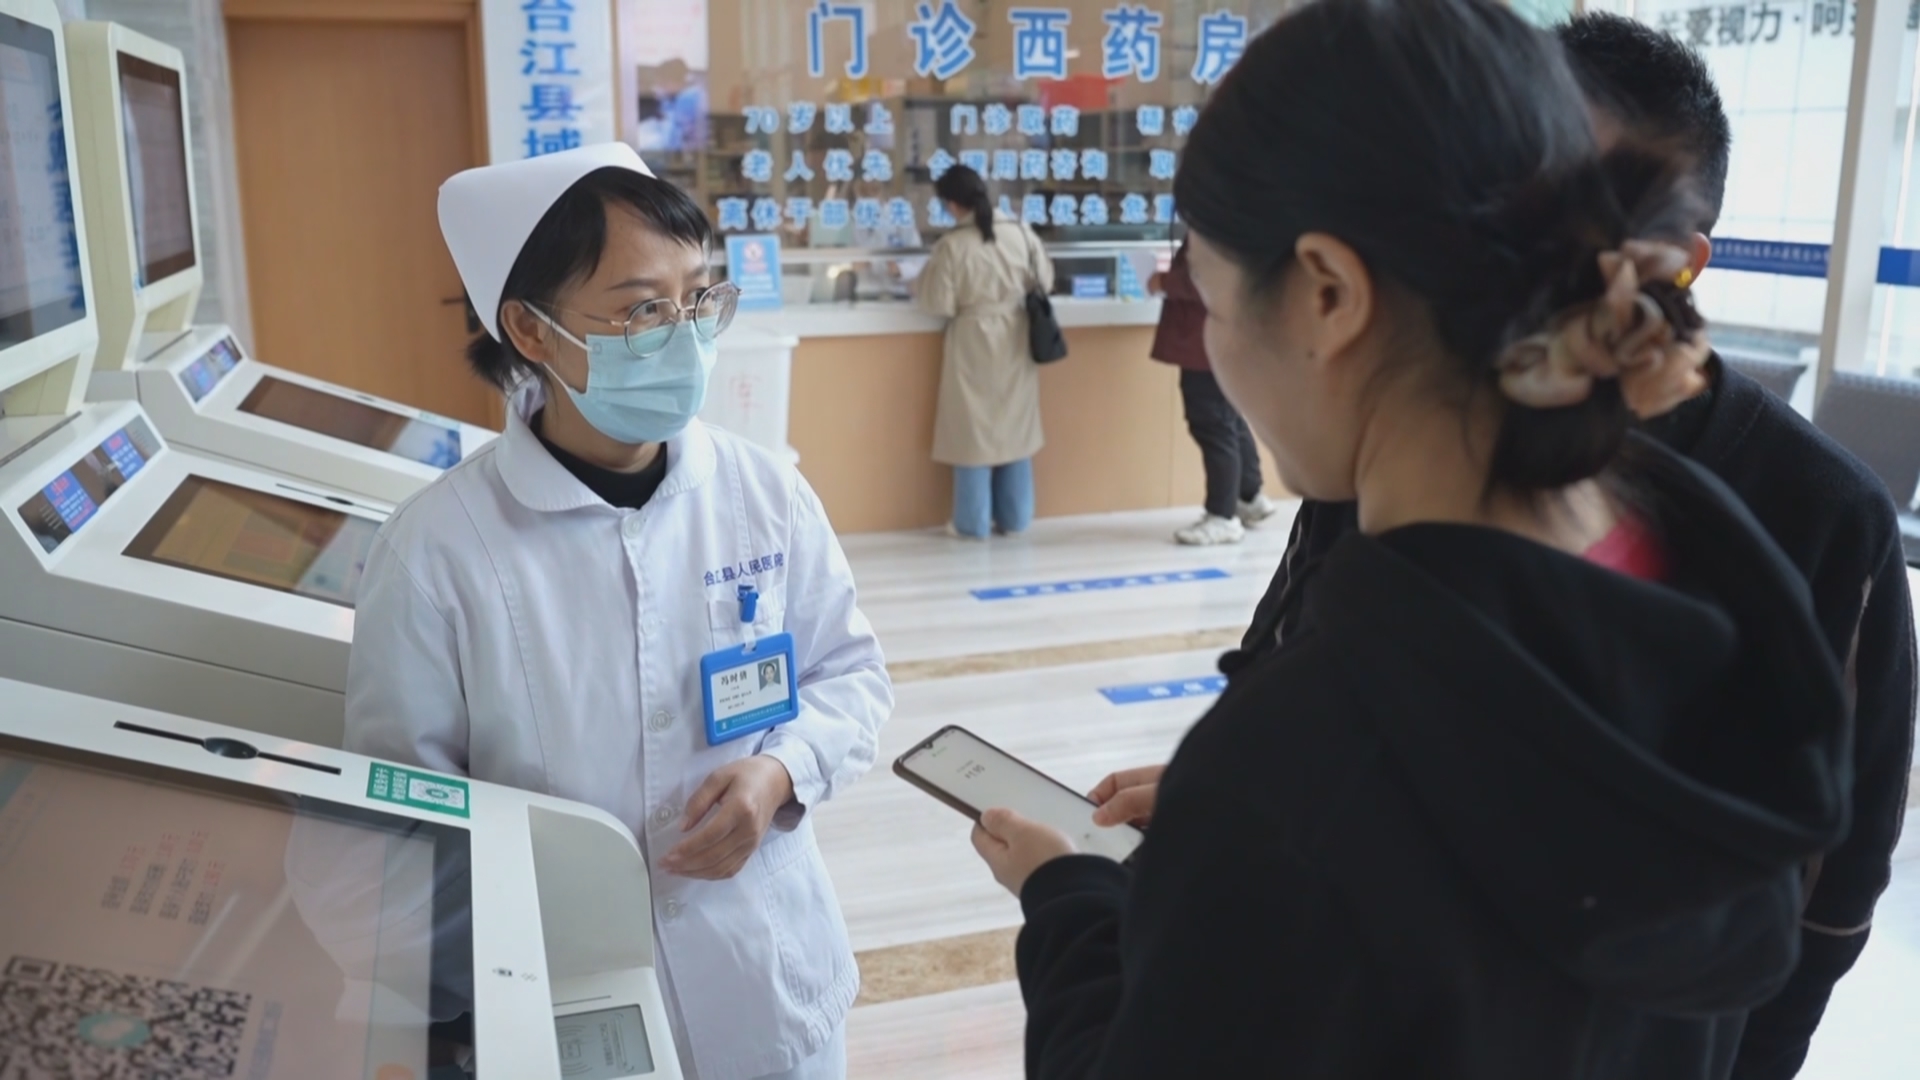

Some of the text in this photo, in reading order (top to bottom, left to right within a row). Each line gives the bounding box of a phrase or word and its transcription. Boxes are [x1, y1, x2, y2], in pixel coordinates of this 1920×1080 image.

[1656, 0, 1857, 46] 关爱视力·呵
[808, 0, 1247, 84] 门诊西药房
[742, 101, 894, 134] 70岁以上
[950, 104, 1080, 137] 门诊取药
[741, 149, 893, 182] 老人优先
[717, 197, 914, 231] 离休干部优先
